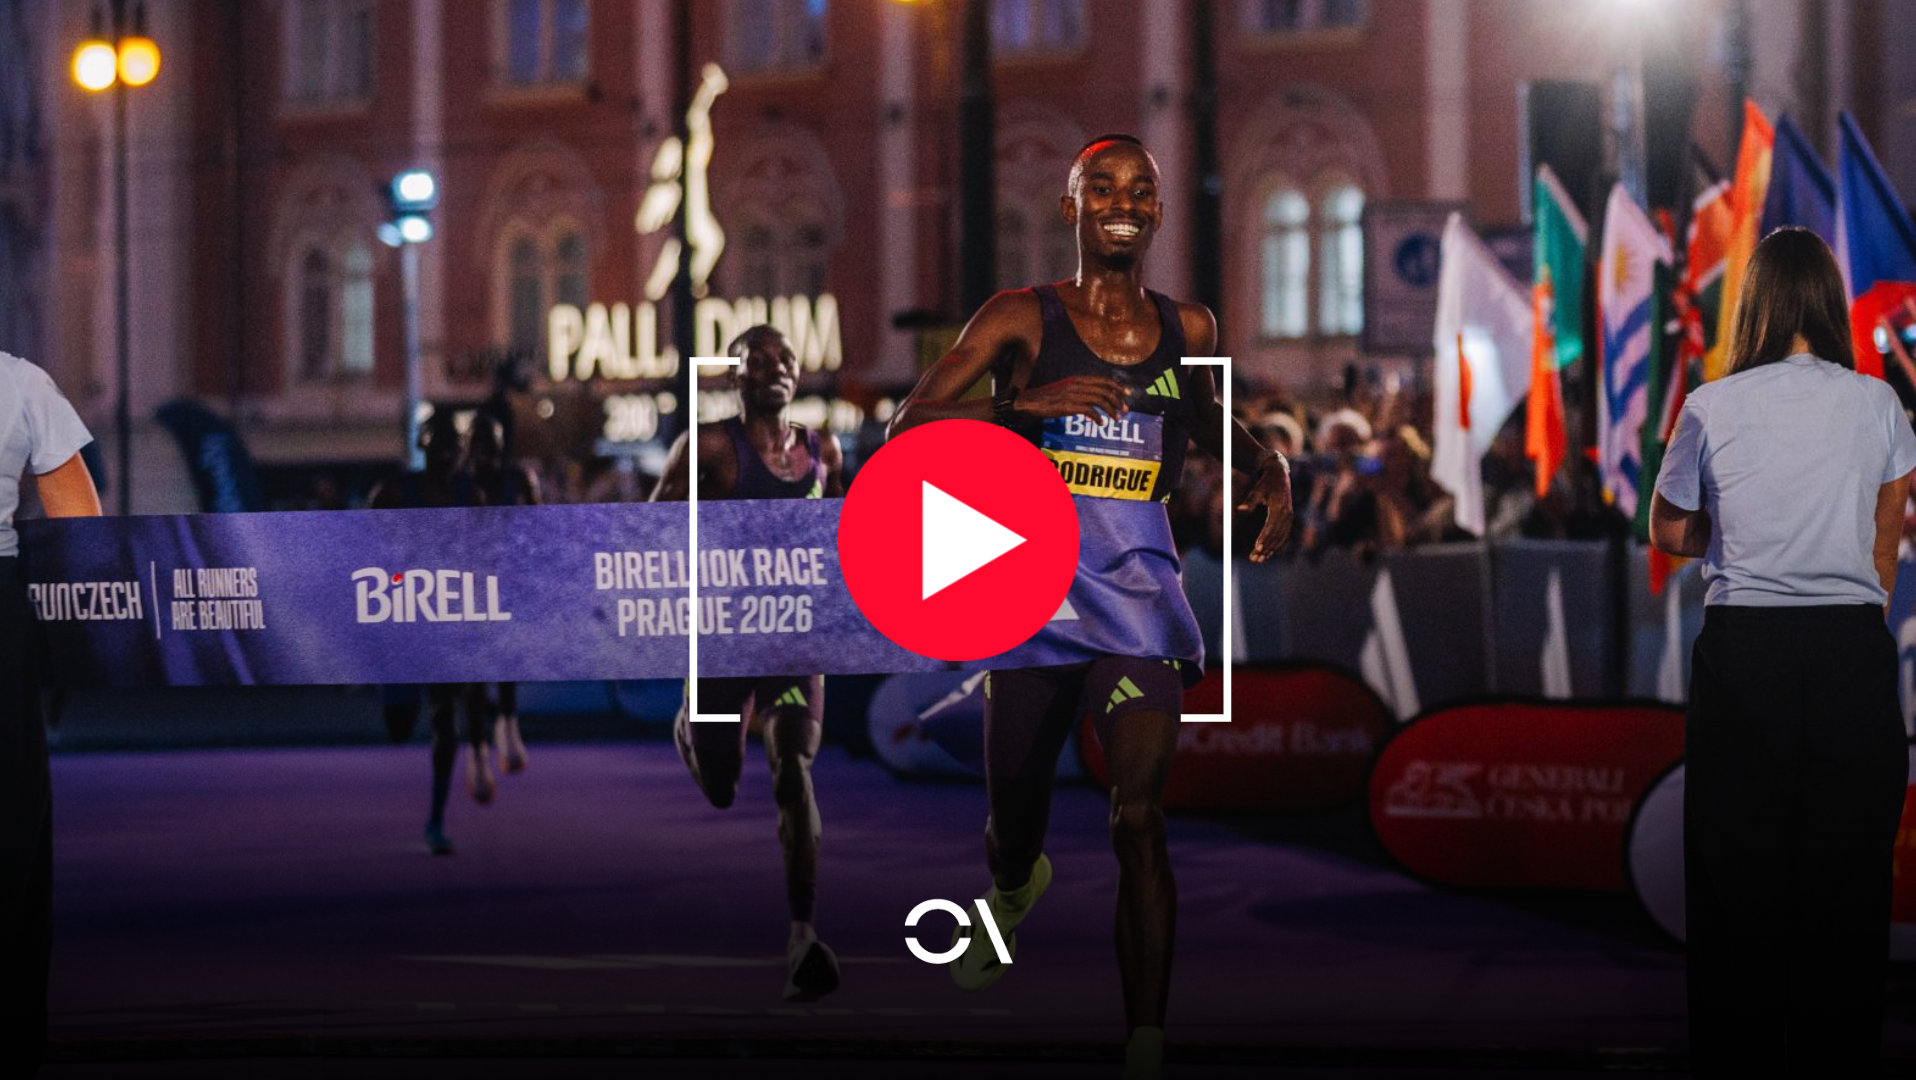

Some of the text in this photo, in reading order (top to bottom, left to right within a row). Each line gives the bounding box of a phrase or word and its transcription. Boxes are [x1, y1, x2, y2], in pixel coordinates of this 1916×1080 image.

[548, 295, 842, 381] PALLDIM
[173, 567, 259, 598] ALL RUNNERS
[594, 547, 828, 590] BIRELL 10K RACE
[171, 599, 266, 630] ARE BEAUTIFUL
[617, 594, 813, 637] PRAGUE 2026
